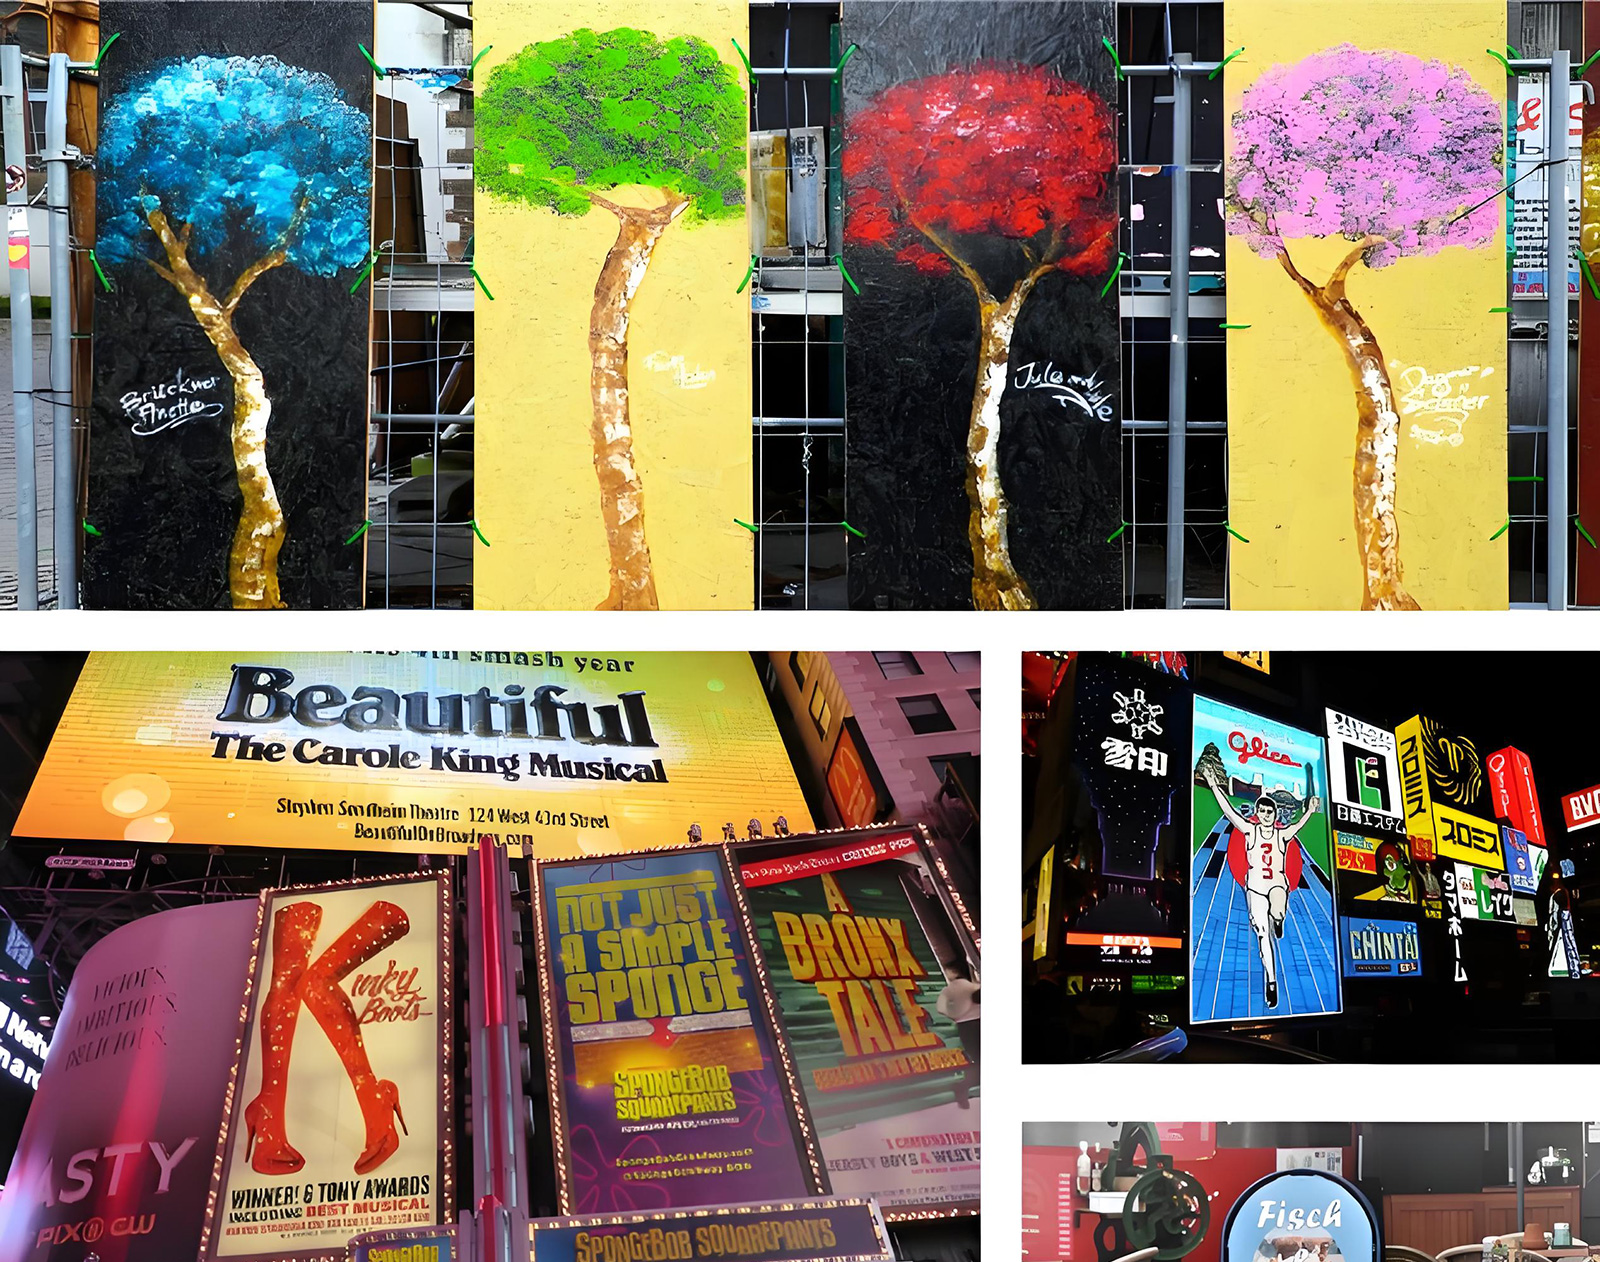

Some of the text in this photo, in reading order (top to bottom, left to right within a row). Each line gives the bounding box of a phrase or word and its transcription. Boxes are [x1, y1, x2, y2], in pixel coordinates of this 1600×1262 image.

[573, 656, 635, 673] year
[215, 663, 659, 748] Beautiful
[210, 731, 670, 784] The Carole King Musical
[1440, 816, 1500, 857] プロミス
[557, 881, 720, 935] NOT JUST
[820, 872, 853, 913] A
[559, 920, 737, 974] A SIMPLE
[771, 909, 928, 983] BRONX
[1442, 869, 1469, 982] タマホーム
[564, 958, 748, 1025] SPONGE
[814, 978, 941, 1057] TALE
[231, 1184, 301, 1210] WINNER!
[317, 1180, 361, 1202] TONY
[363, 1175, 431, 1200] AWARDS
[352, 1197, 430, 1215] MUSICAL
[1257, 1198, 1342, 1231] Fisch
[695, 1218, 838, 1258] SQUAREPANTS
